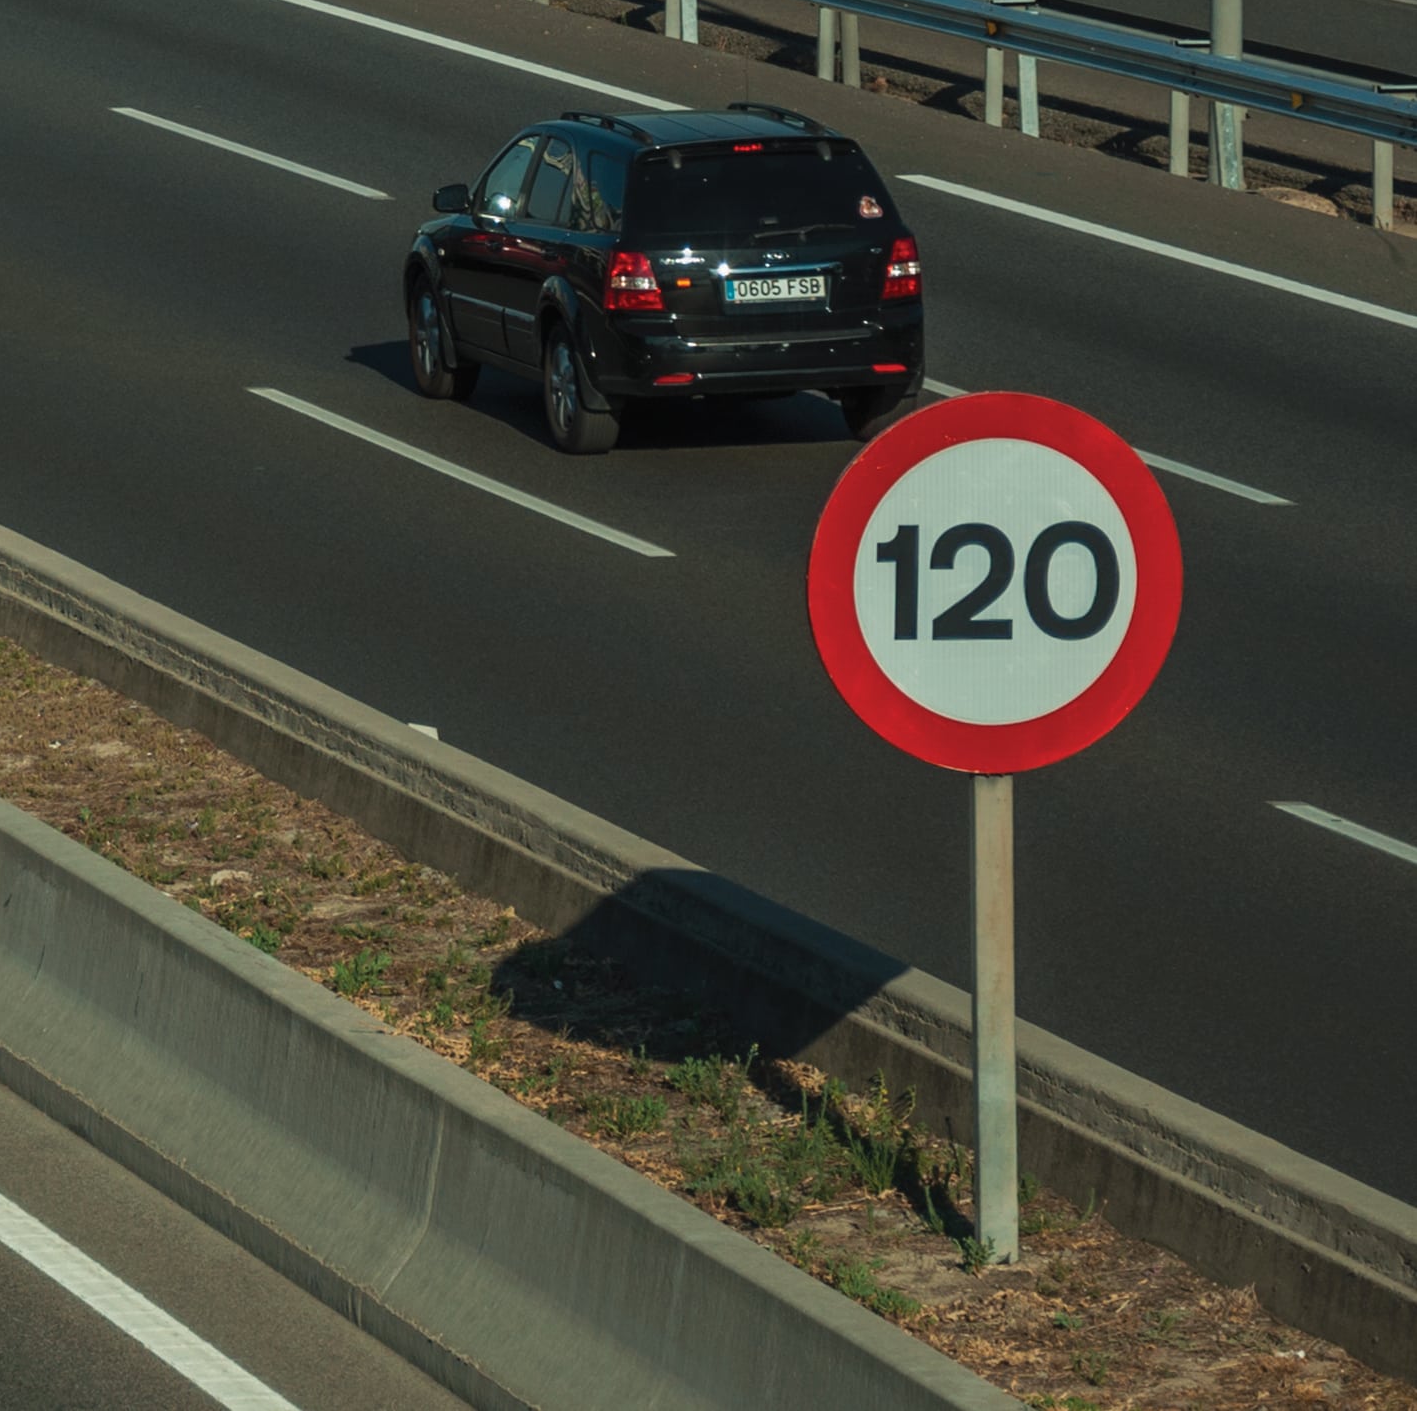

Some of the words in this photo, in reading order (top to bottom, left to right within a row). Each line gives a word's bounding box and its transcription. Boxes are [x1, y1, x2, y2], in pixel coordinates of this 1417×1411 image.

[737, 278, 782, 298] 0605
[787, 277, 821, 296] FSB
[875, 520, 1121, 643] 120
